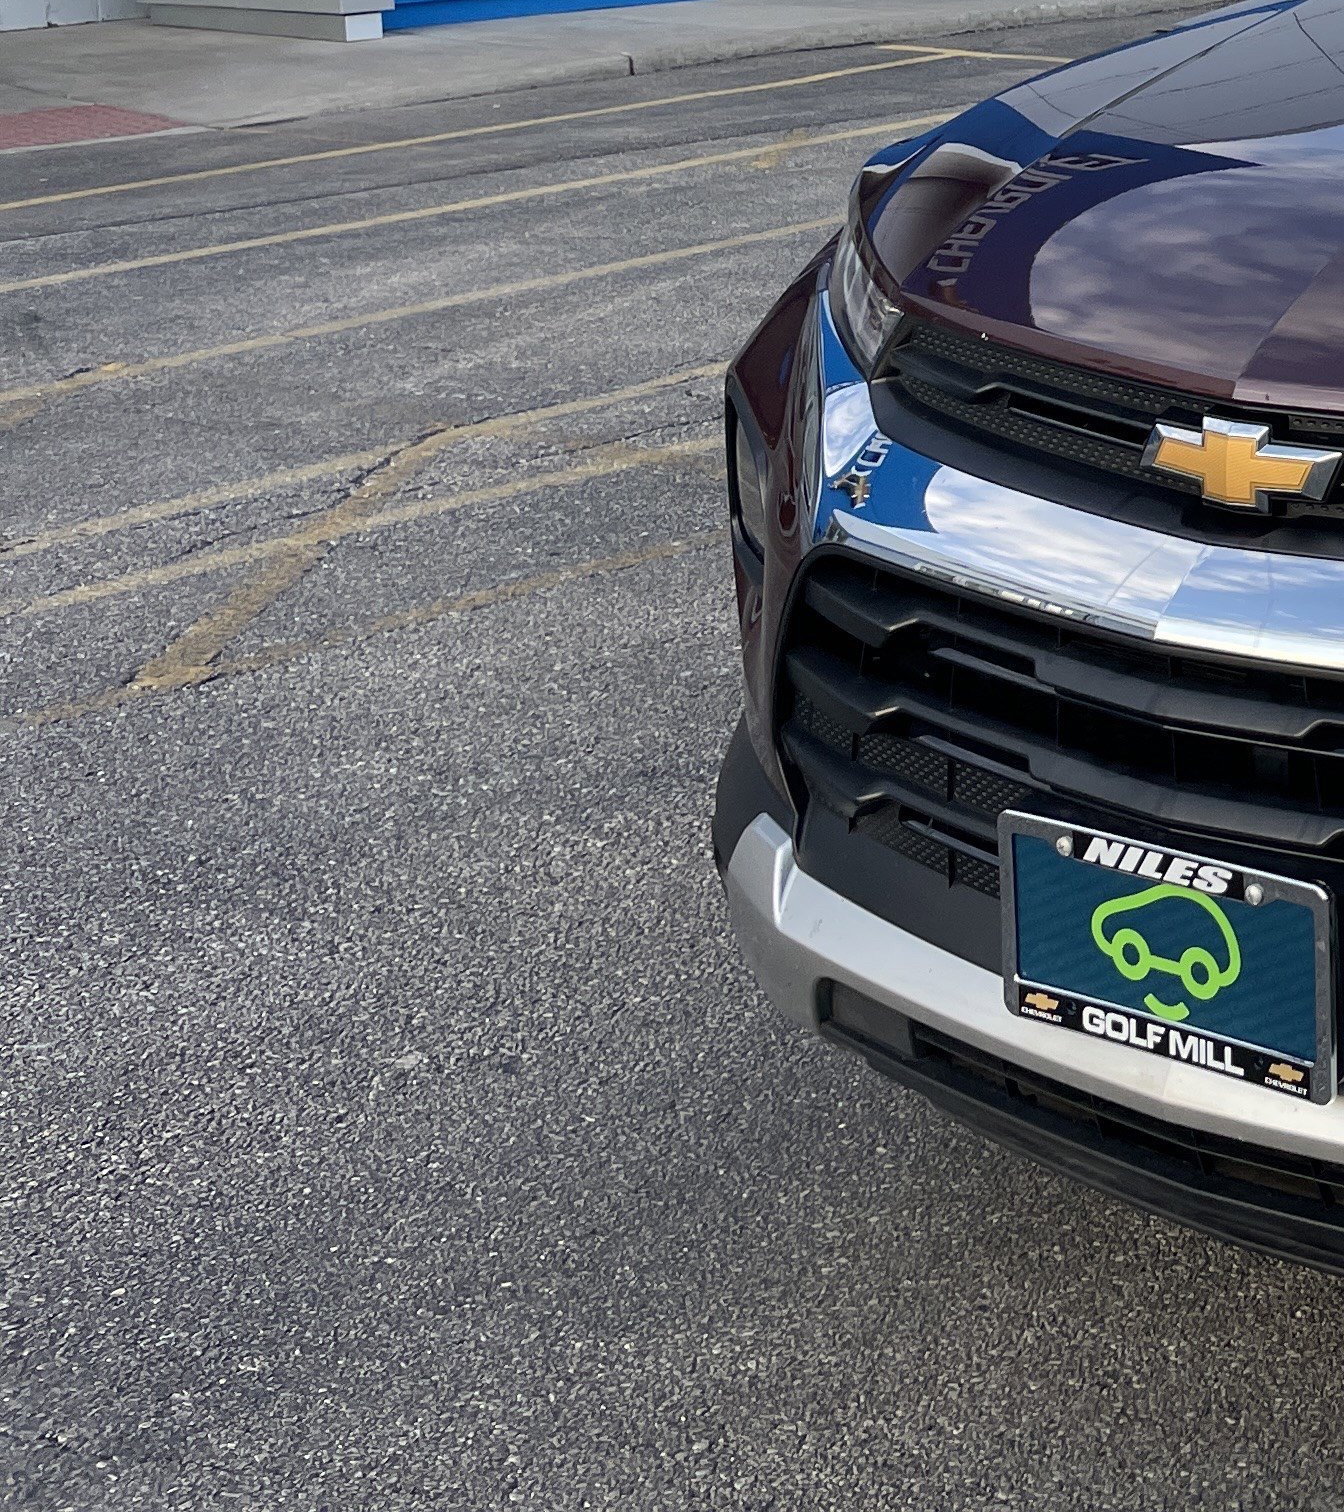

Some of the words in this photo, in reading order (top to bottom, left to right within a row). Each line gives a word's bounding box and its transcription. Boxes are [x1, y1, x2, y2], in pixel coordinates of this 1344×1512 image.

[1082, 836, 1234, 895] NILES
[1020, 1006, 1063, 1024] CHEVROLET
[1081, 1005, 1167, 1048] GOLF
[1168, 1029, 1245, 1076] MILL
[1264, 1076, 1308, 1096] CHEVROLET
